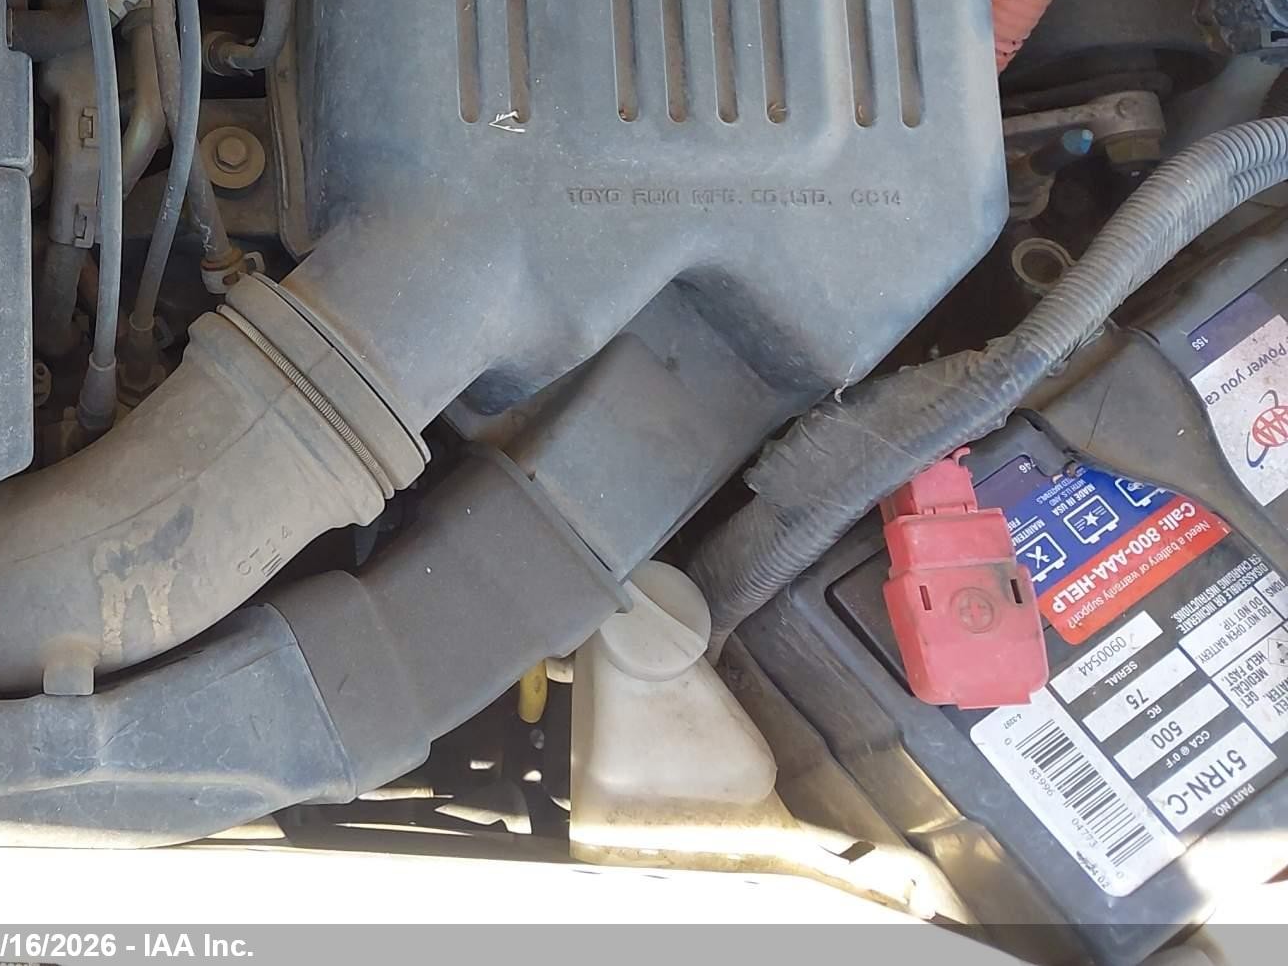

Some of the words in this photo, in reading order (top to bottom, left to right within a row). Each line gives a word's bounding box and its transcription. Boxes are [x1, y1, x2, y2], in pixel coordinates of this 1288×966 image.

[567, 187, 622, 205] TOYO
[1191, 336, 1209, 351] 155
[1244, 343, 1285, 377] Power
[1220, 368, 1245, 394] you
[1203, 390, 1221, 407] ca
[1049, 495, 1061, 506] AND
[1065, 496, 1076, 507] IN
[1073, 482, 1094, 501] MADE
[1051, 502, 1067, 516] USA
[1161, 502, 1196, 532] Call:
[1177, 537, 1184, 545] a
[1184, 519, 1210, 542] Need
[1147, 540, 1179, 568] battery
[1048, 526, 1161, 614] 800-AAA-HELP
[1138, 562, 1149, 574] or
[1216, 560, 1251, 590] CHARGING
[1102, 569, 1139, 600] warranty
[1223, 562, 1268, 599] DISASSEMBLE
[1066, 593, 1103, 628] support?
[1170, 584, 1220, 624] INSTRUCTIONS.
[1213, 594, 1225, 607] OR
[1247, 595, 1262, 611] DO
[1257, 604, 1271, 618] DO
[1176, 601, 1216, 635] INCINERATE.
[1219, 616, 1235, 631] TIP.
[1232, 604, 1250, 621] NOT
[1244, 612, 1261, 628] NOT
[1225, 623, 1246, 643] OPEN
[1076, 634, 1126, 676] 0900544
[1195, 637, 1227, 665] BATTERY.
[1244, 649, 1265, 671] HELP
[1104, 659, 1137, 688] SERIAL
[1221, 665, 1246, 688] FAST.
[1230, 665, 1267, 698] MEDICAL
[1124, 686, 1148, 710] 75
[1240, 689, 1258, 708] GET
[1145, 703, 1161, 719] RC
[1149, 719, 1182, 750] 500
[1188, 729, 1210, 749] CCA
[1167, 748, 1247, 815] 51RN-C
[1229, 782, 1254, 805] PART
[1029, 766, 1054, 797] 83996
[1072, 817, 1098, 849] 04773
[1212, 801, 1230, 818] NO.
